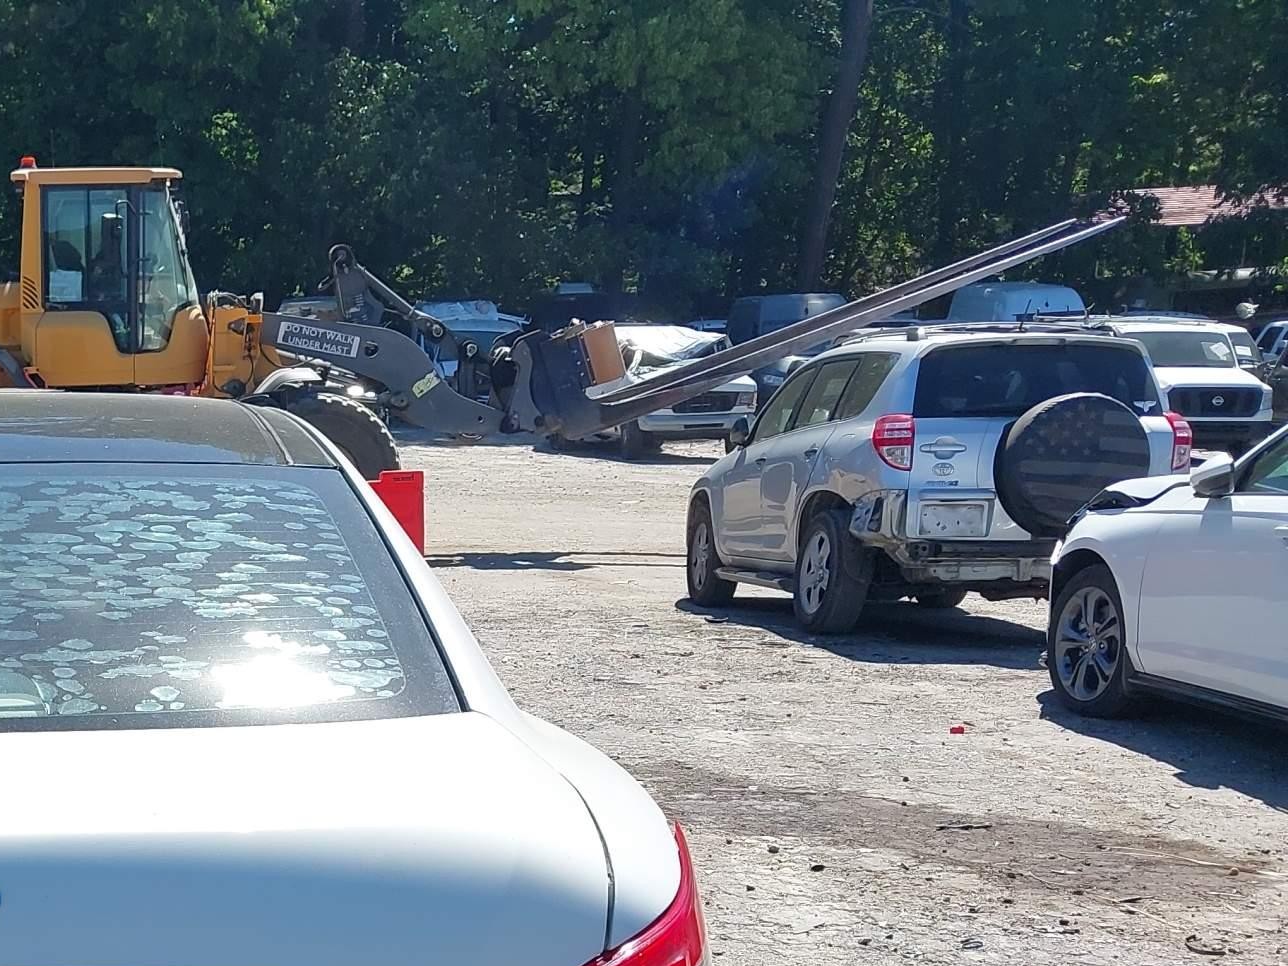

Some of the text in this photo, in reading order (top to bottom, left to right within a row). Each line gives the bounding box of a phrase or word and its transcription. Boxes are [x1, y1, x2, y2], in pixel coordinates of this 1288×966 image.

[286, 324, 354, 344] DO NOT WALK
[288, 335, 349, 354] UNDER MAST
